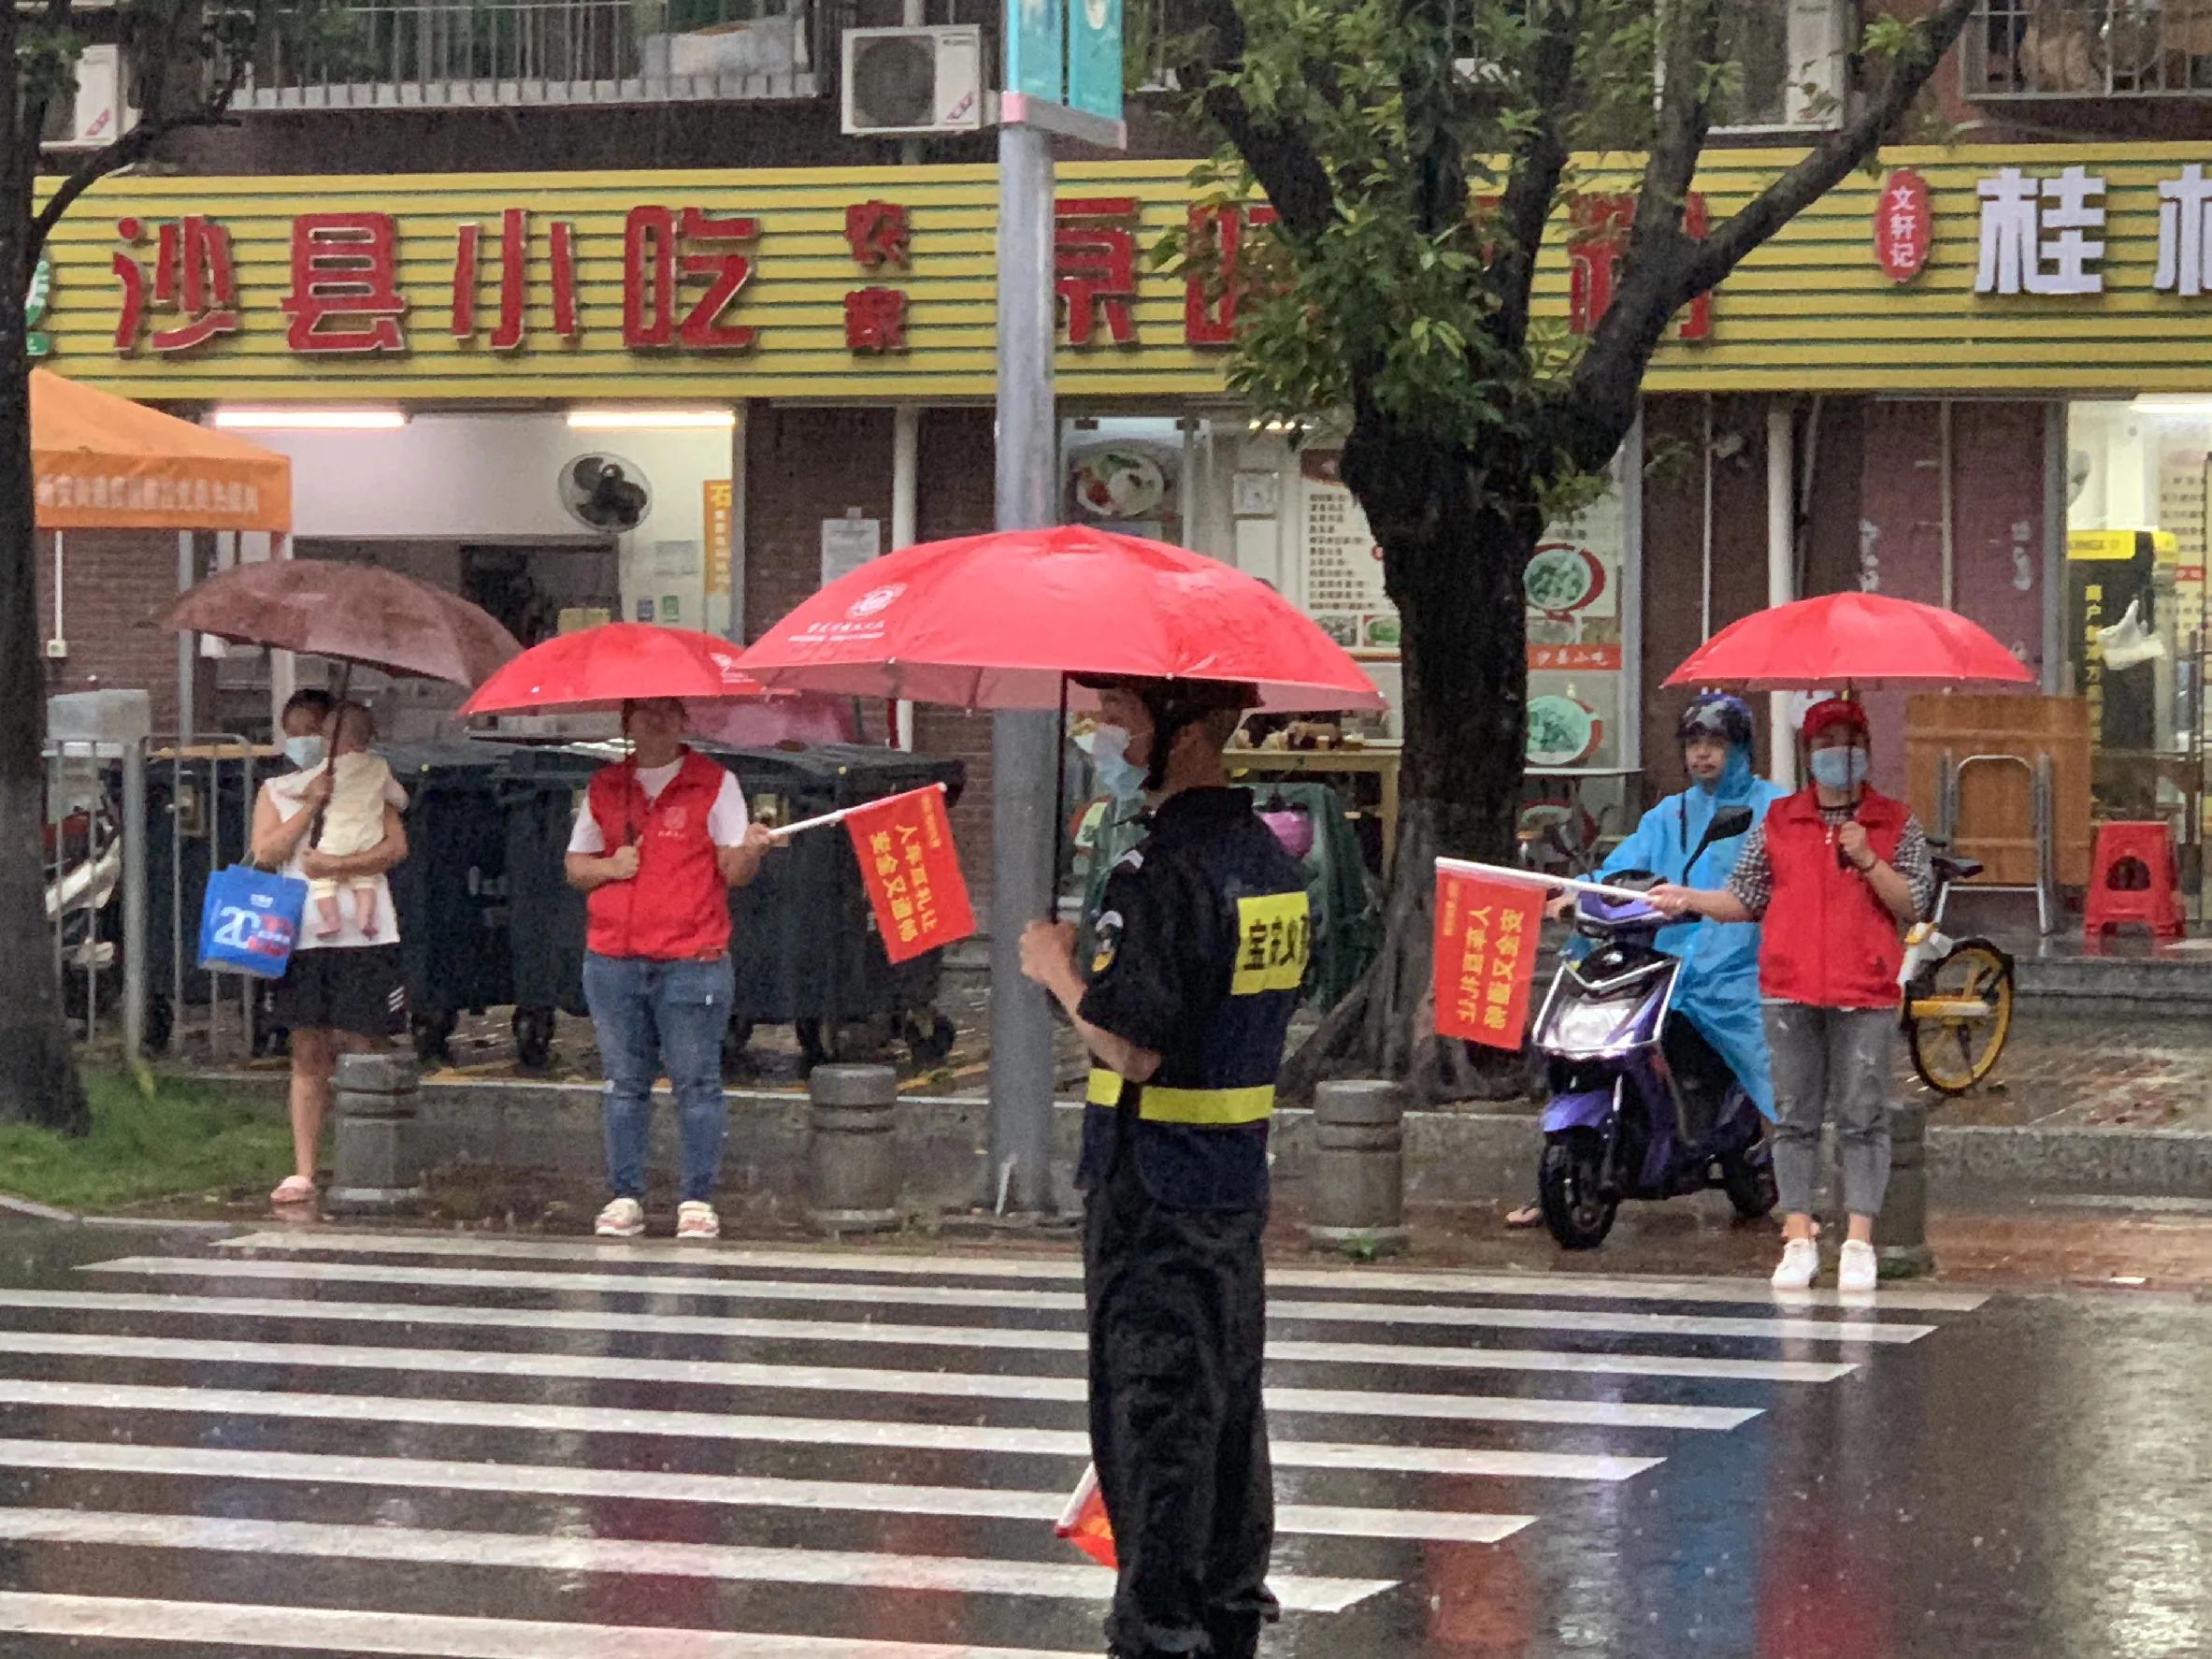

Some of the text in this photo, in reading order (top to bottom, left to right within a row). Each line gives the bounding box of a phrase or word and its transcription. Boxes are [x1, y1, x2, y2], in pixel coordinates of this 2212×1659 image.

[112, 204, 757, 352] 沙县小吃
[1889, 185, 1917, 269] 文轩记
